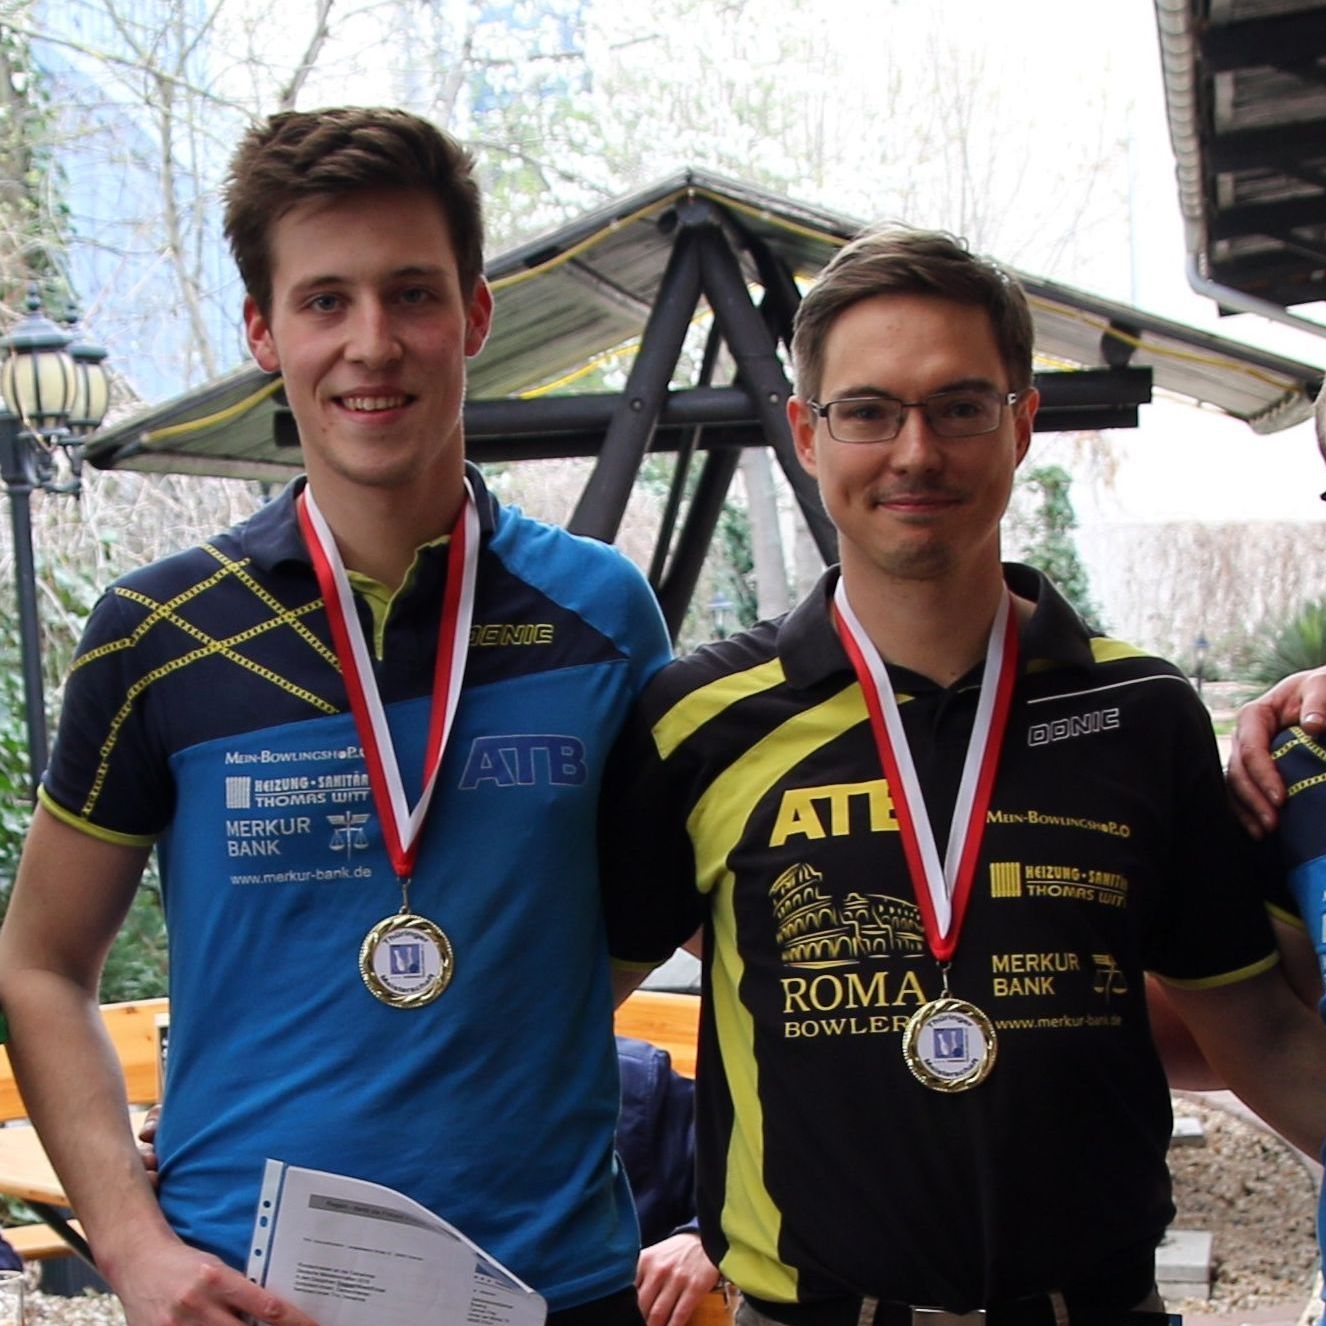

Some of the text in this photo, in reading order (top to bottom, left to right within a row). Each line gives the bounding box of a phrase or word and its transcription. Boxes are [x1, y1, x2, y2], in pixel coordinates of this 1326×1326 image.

[1028, 708, 1119, 747] DONIC
[458, 734, 589, 790] ATB
[255, 791, 369, 808] THOMAS WITT
[226, 817, 311, 837] MERKUR
[227, 839, 281, 857] BANK
[230, 865, 373, 885] www.merkur-bank.de
[1026, 884, 1095, 901] THOMAS
[991, 953, 1080, 973] MERKUR
[780, 970, 928, 1014] ROMA
[993, 976, 1056, 997] BANK
